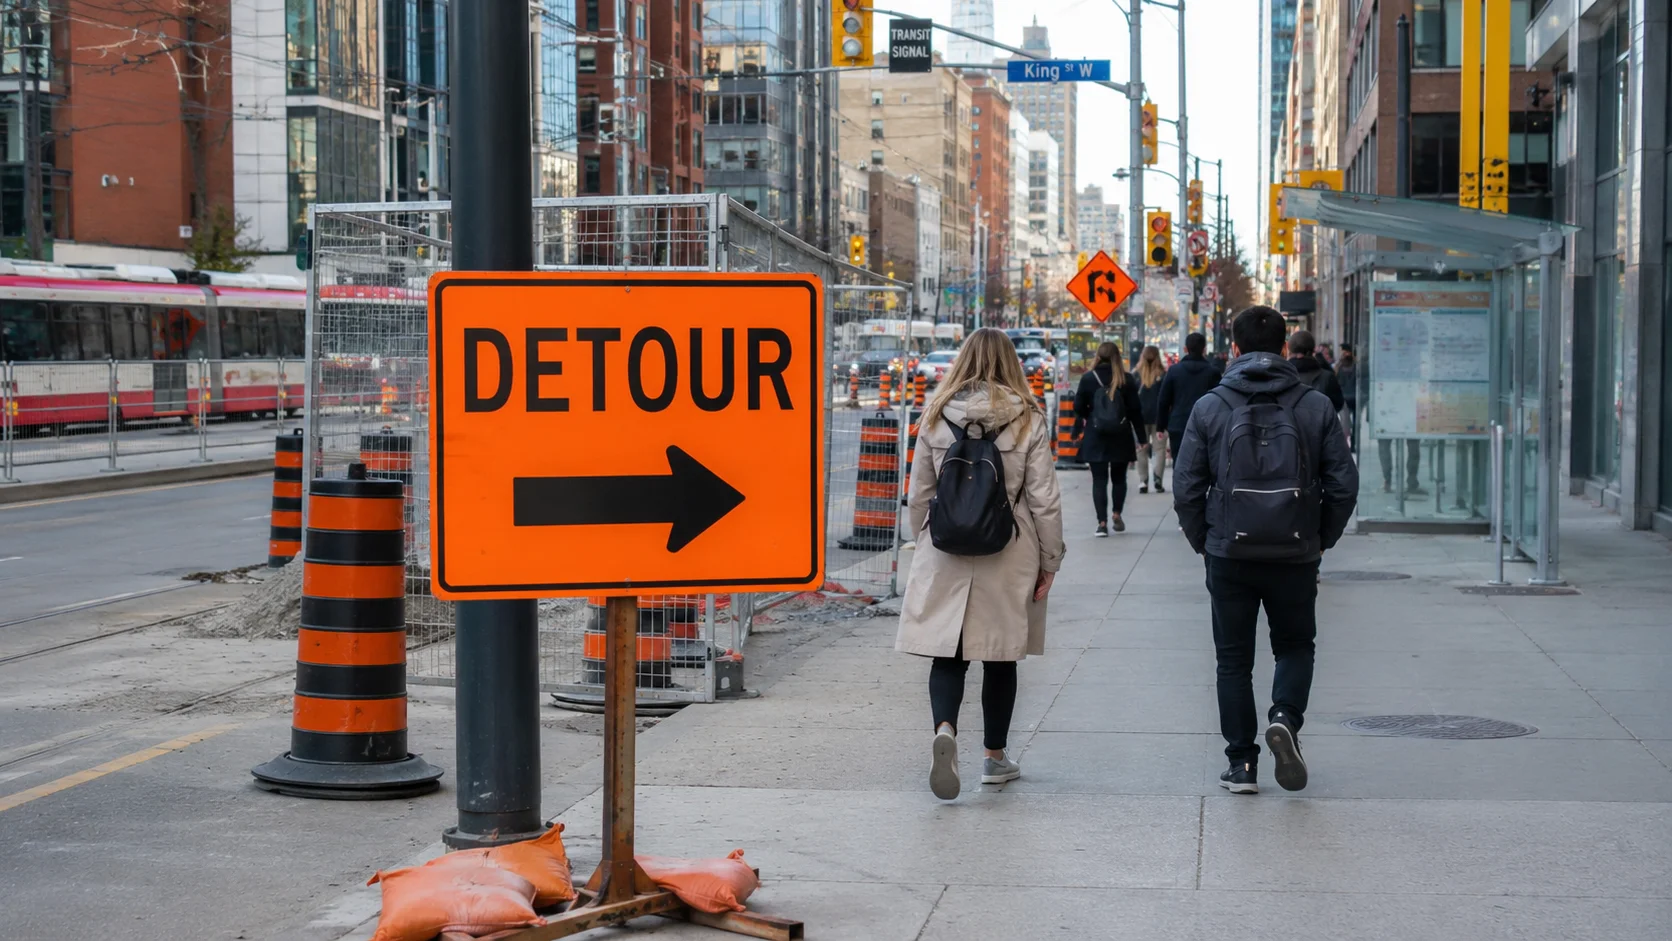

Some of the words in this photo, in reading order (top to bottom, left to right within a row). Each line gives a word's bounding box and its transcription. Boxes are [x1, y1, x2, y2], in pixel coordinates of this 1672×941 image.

[891, 28, 930, 41] TRANSIT
[892, 45, 929, 58] SIGNAL
[1024, 63, 1060, 80] King
[1064, 63, 1074, 72] St
[1079, 63, 1093, 78] W
[463, 326, 795, 413] DETOUR
